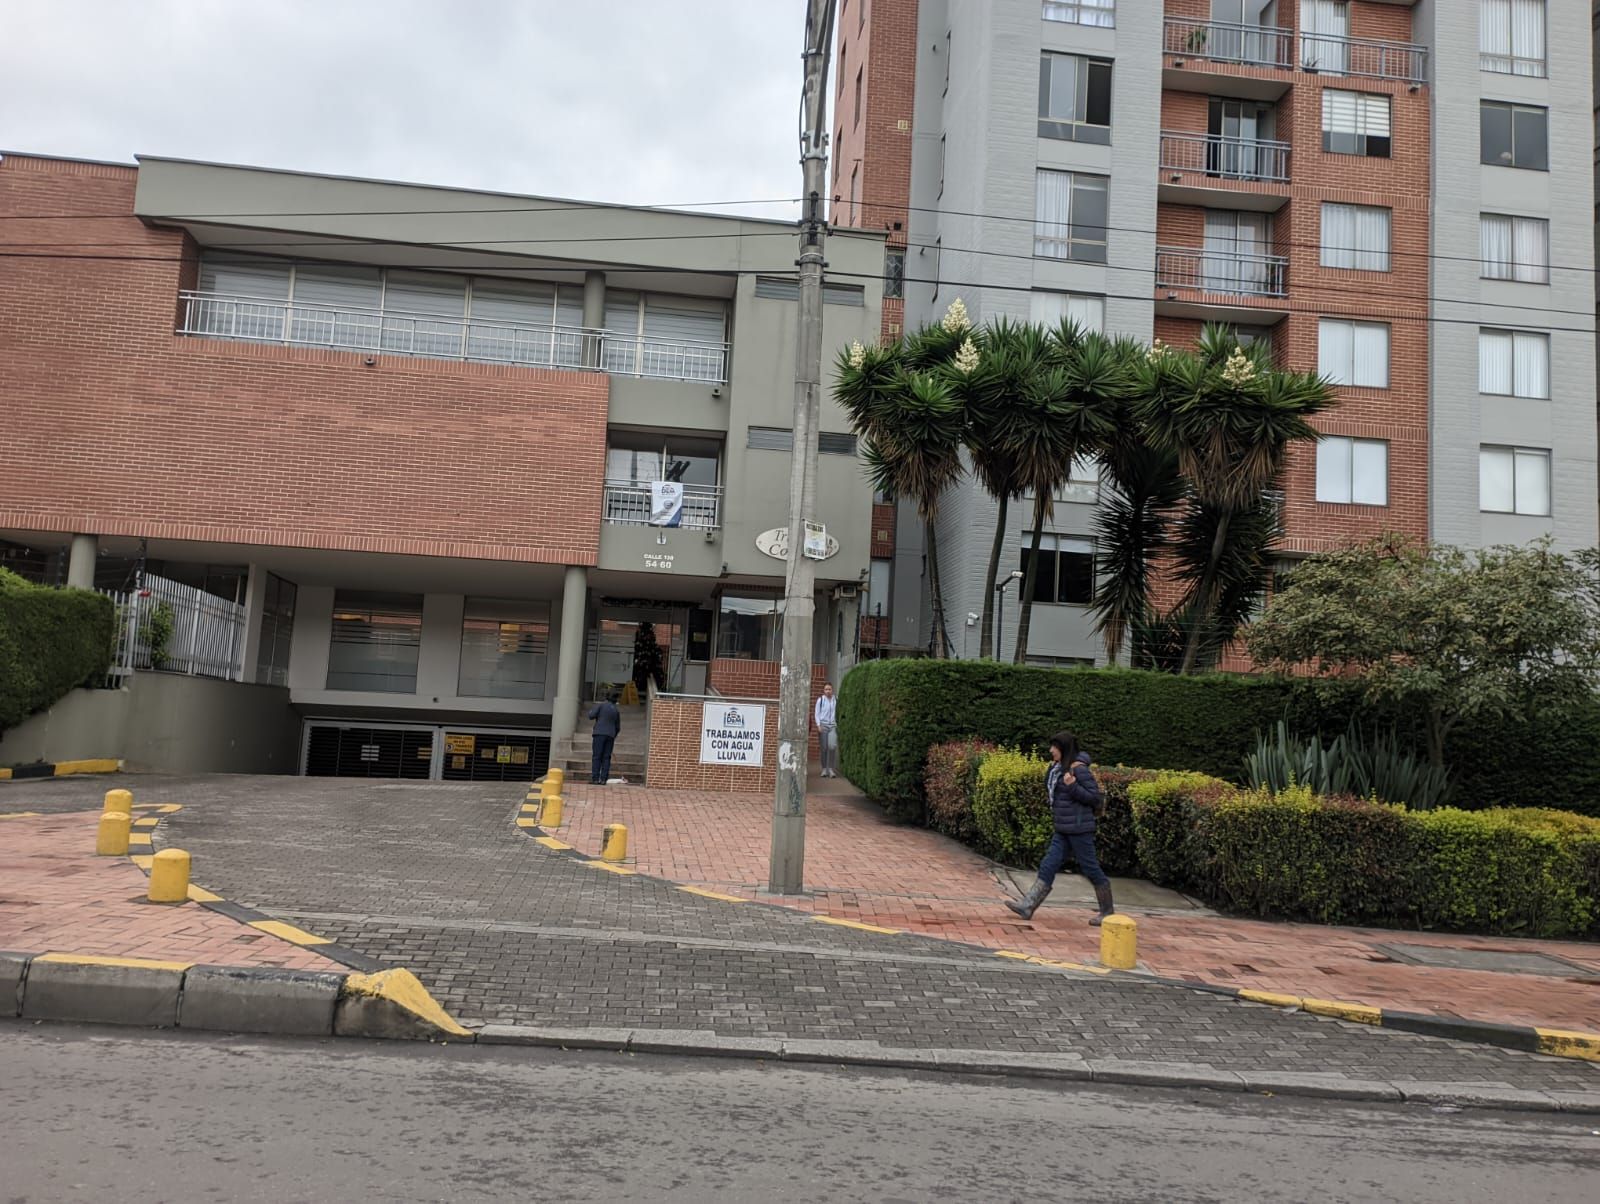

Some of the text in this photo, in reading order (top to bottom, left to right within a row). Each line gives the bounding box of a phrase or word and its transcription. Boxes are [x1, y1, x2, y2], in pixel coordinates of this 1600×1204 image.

[775, 530, 789, 542] Tr
[769, 544, 788, 556] Co
[660, 561, 672, 569] 60
[706, 729, 761, 740] TRABAJAMOS
[711, 740, 754, 751] CON AGUA
[717, 751, 747, 761] LLUVIA
